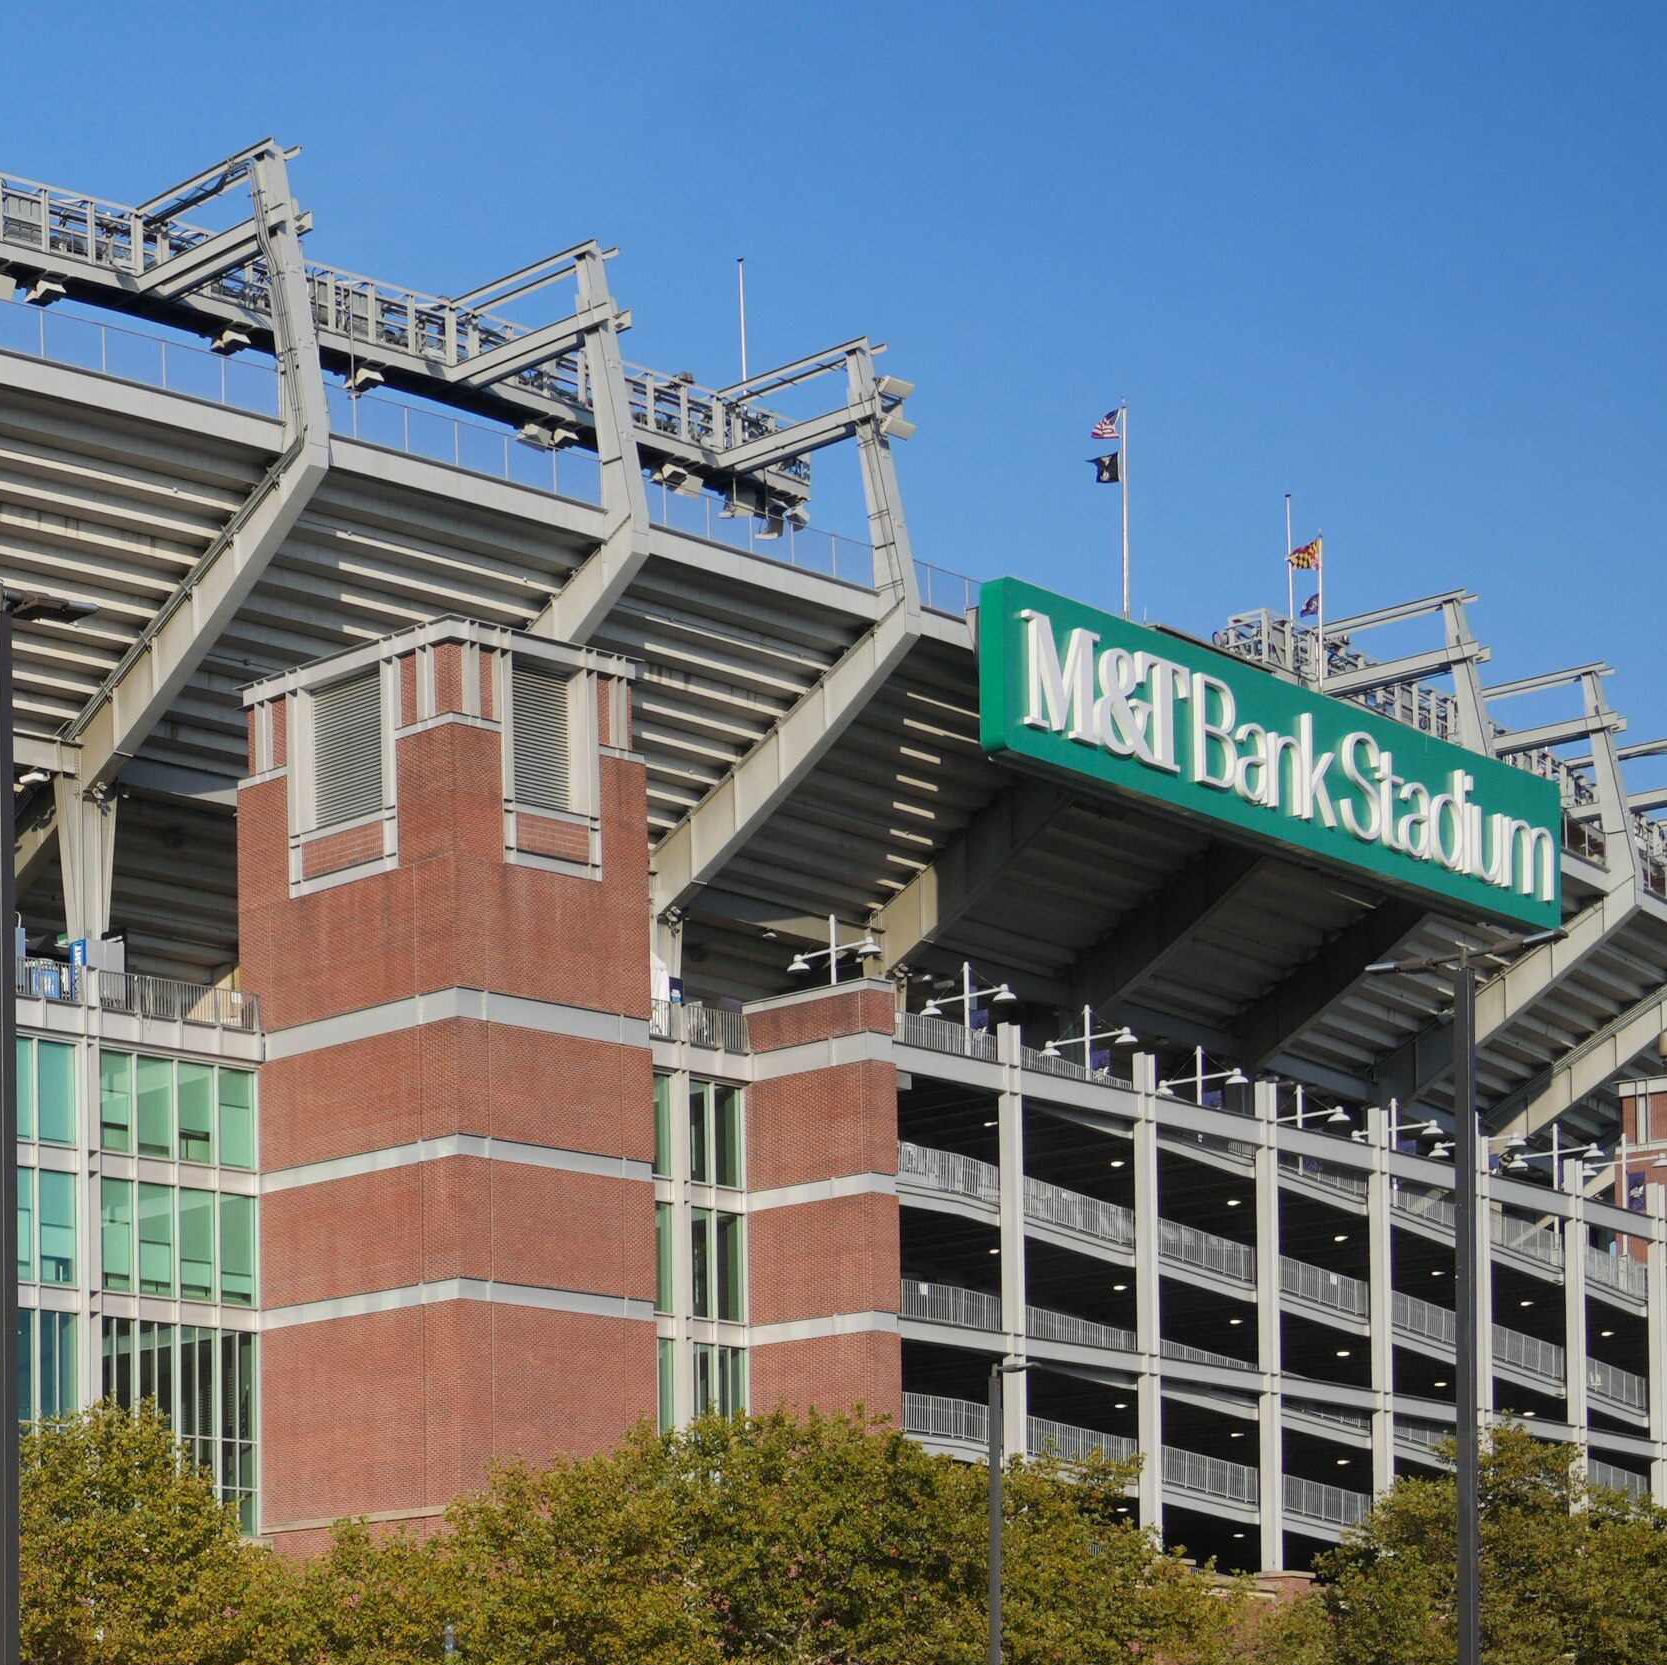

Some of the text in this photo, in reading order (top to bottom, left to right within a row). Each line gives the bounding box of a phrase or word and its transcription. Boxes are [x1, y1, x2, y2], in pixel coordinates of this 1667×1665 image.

[1020, 608, 1555, 902] M&T Bank Stadium
